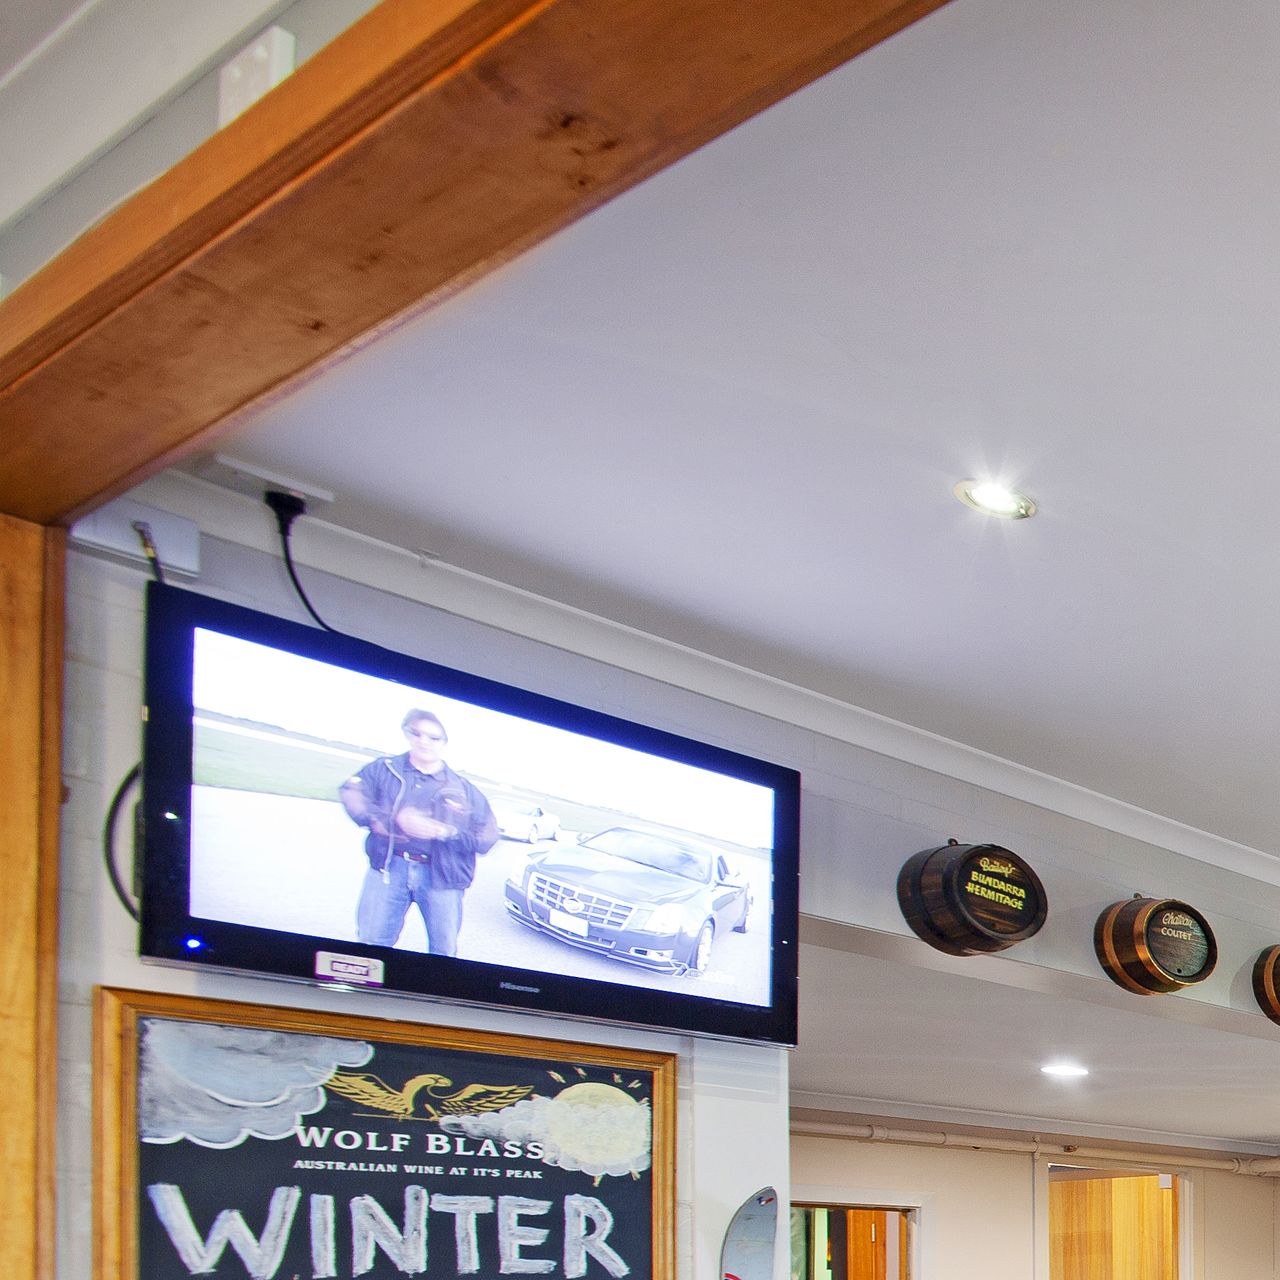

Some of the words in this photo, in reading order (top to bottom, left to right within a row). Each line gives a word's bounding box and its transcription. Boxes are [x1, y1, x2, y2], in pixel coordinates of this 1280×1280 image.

[965, 882, 1024, 910] HERMITAGE
[971, 871, 1026, 899] BUNDARRA
[500, 981, 541, 994] Hisense
[297, 1124, 411, 1154] WOLF
[426, 1132, 545, 1161] BLASS
[293, 1159, 398, 1175] AUSTRALIAN
[404, 1164, 443, 1178] WINE
[449, 1166, 467, 1178] AT
[472, 1167, 501, 1179] IT'S
[505, 1168, 543, 1180] PEAK
